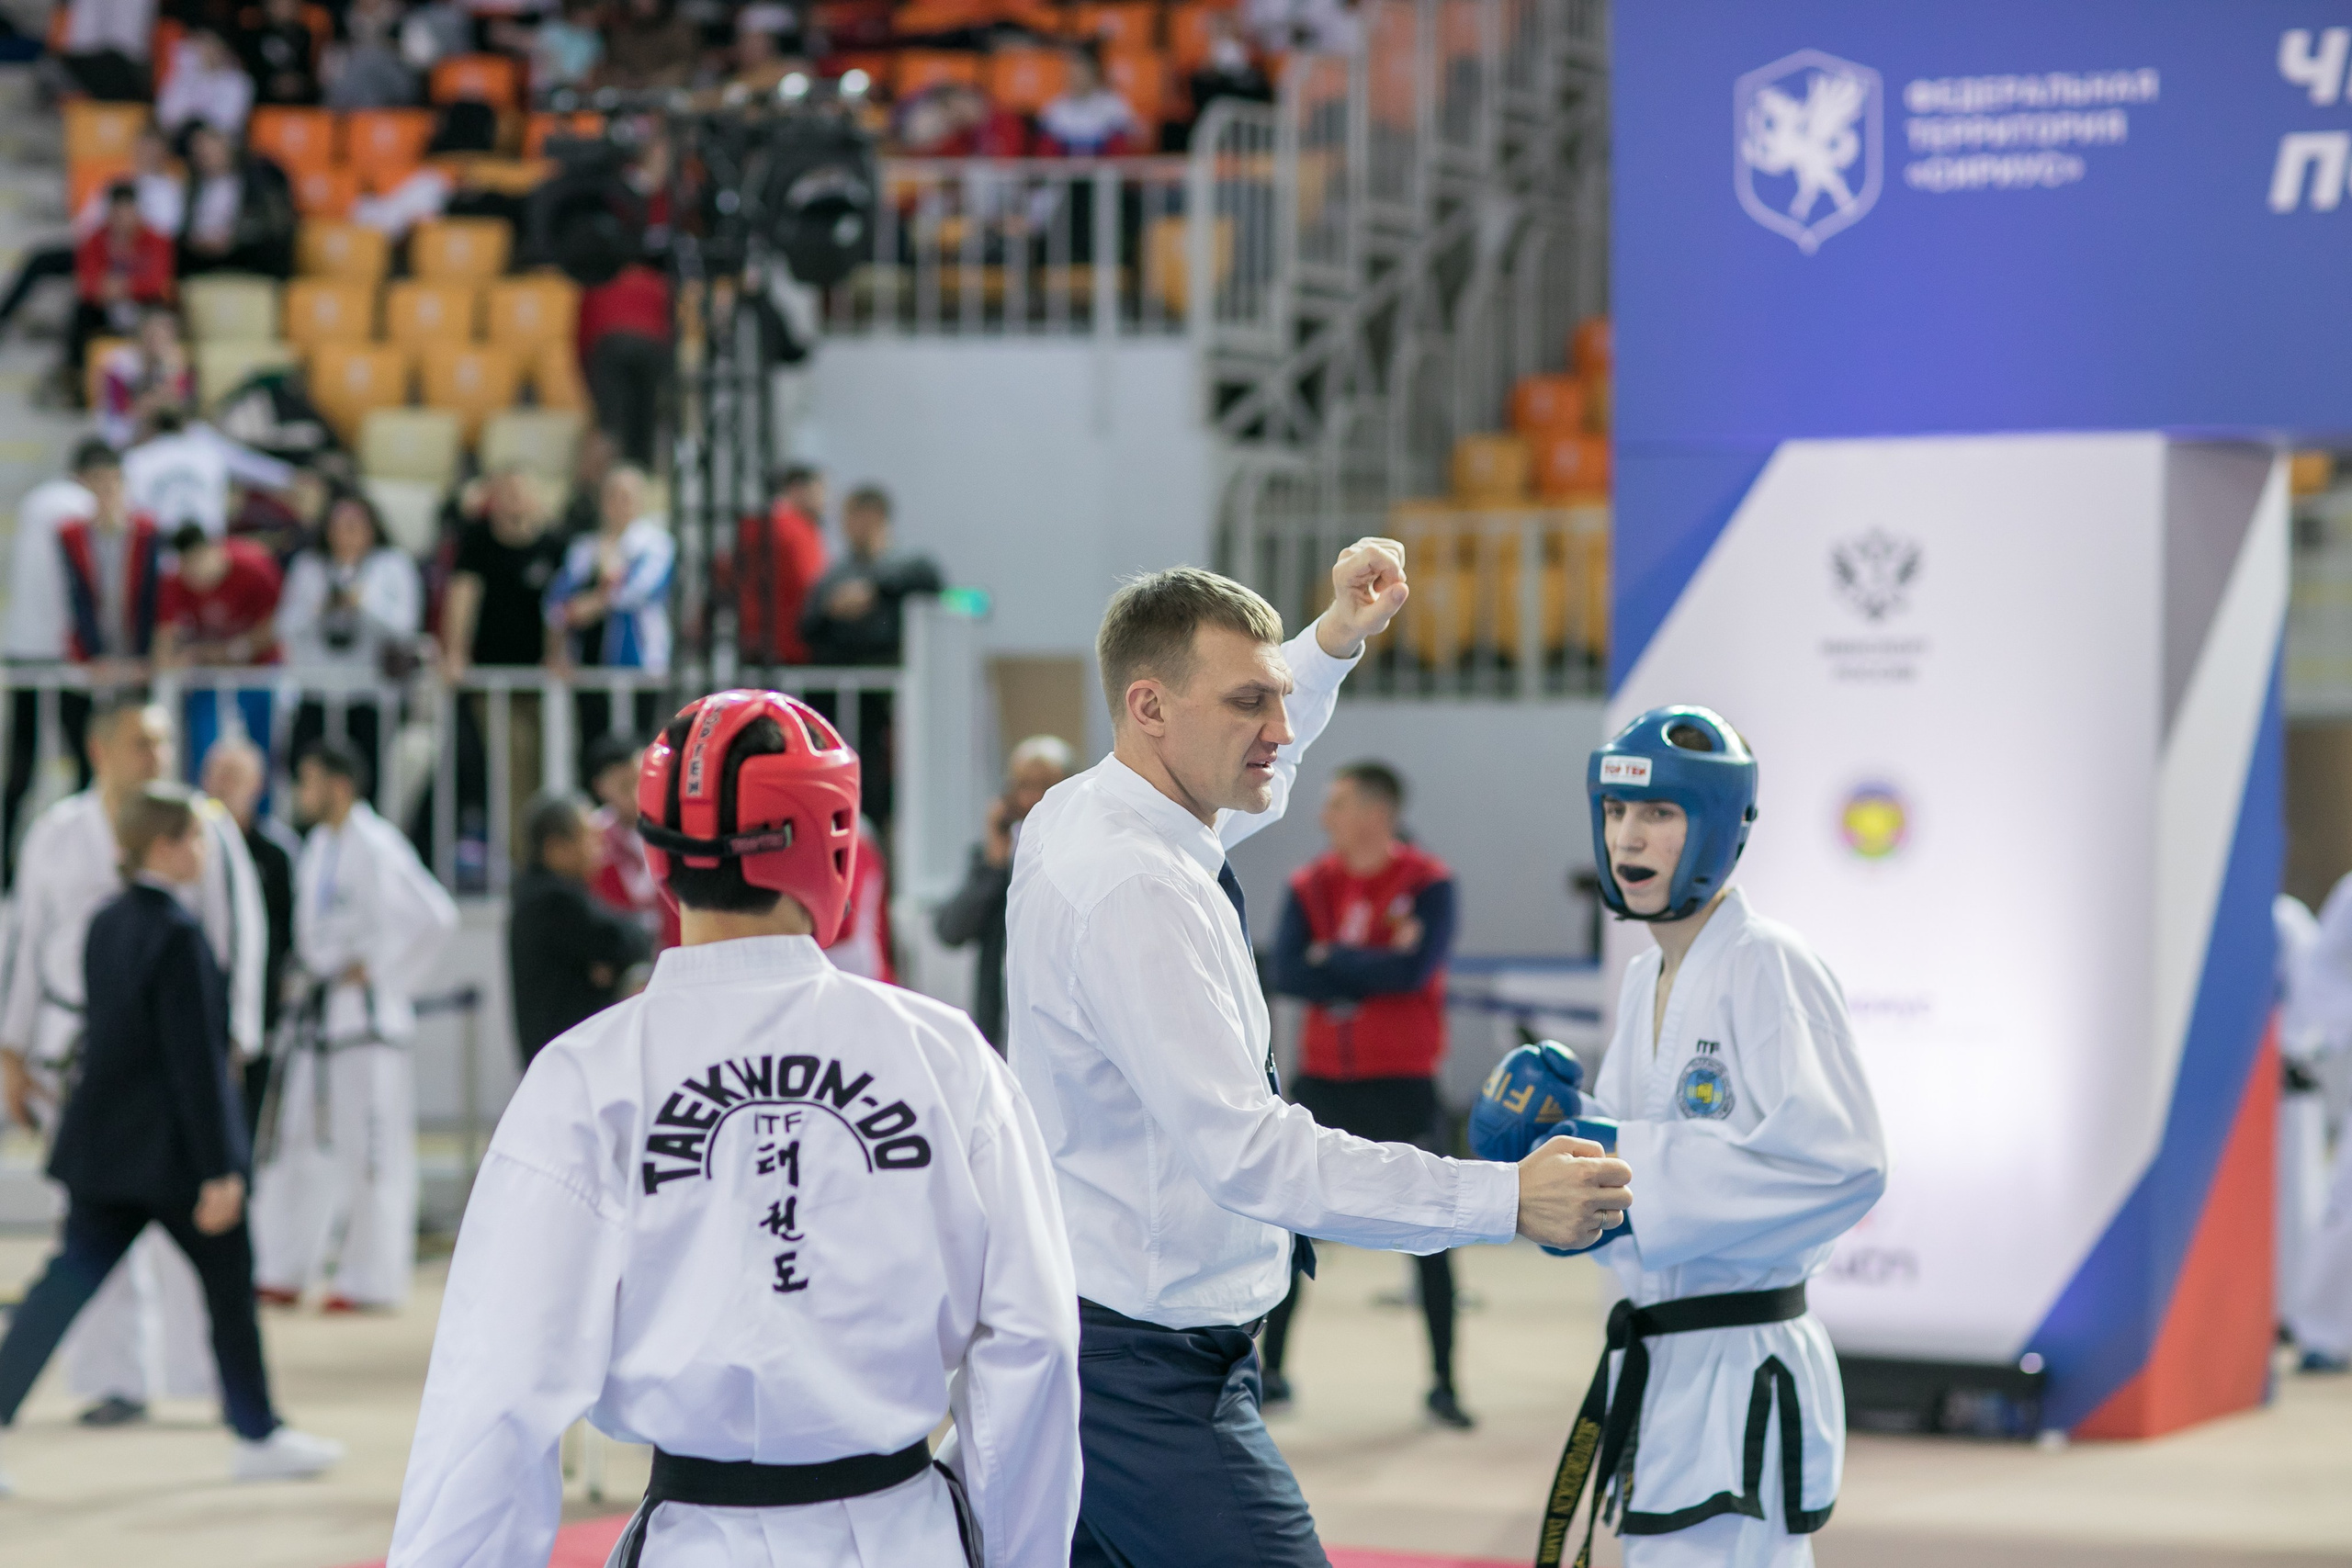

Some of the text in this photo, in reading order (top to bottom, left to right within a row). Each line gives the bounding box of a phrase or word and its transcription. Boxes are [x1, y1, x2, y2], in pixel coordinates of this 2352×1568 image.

[1696, 1039, 1720, 1054] ITF
[642, 1055, 932, 1195] TAEKWON-DO
[754, 1111, 802, 1134] ITF
